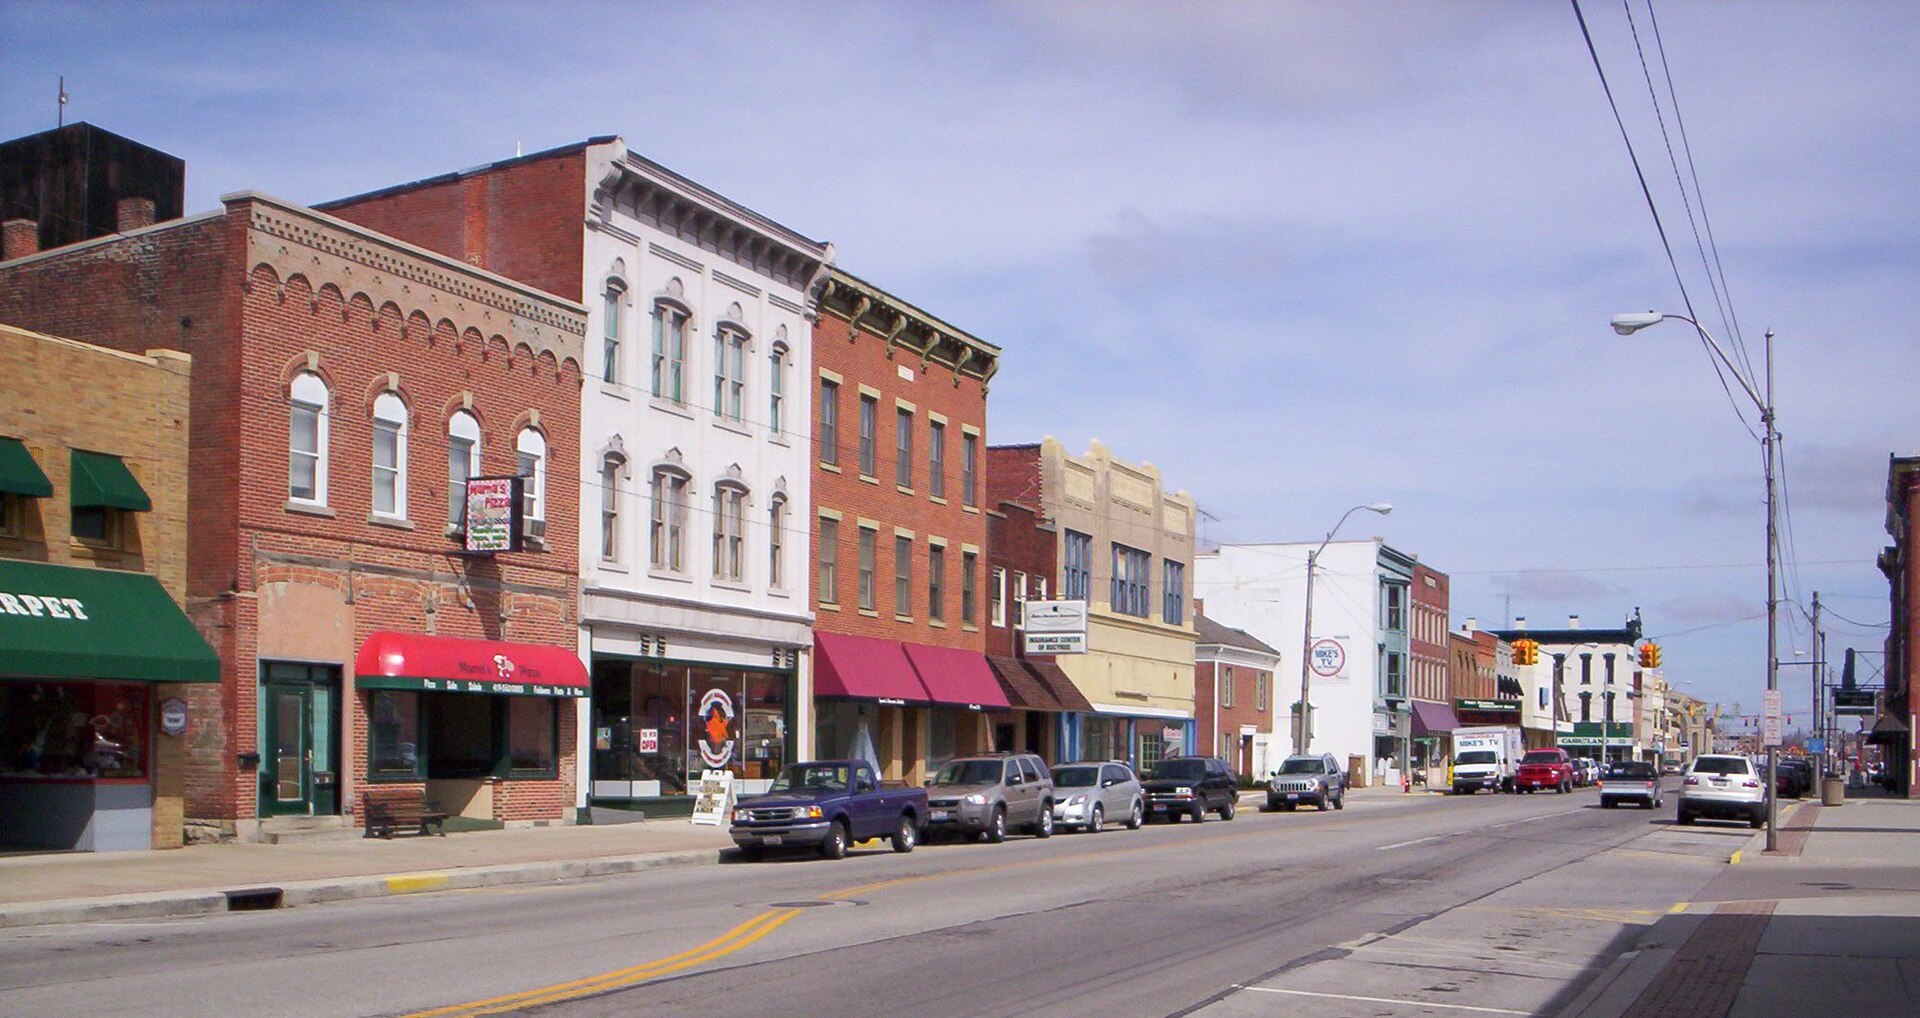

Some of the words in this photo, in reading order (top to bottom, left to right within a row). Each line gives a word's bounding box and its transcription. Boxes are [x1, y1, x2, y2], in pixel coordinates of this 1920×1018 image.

[1315, 649, 1339, 658] MIKE'S
[642, 740, 657, 750] OPEN
[1459, 739, 1484, 747] MIKE'S
[1488, 738, 1500, 746] TV
